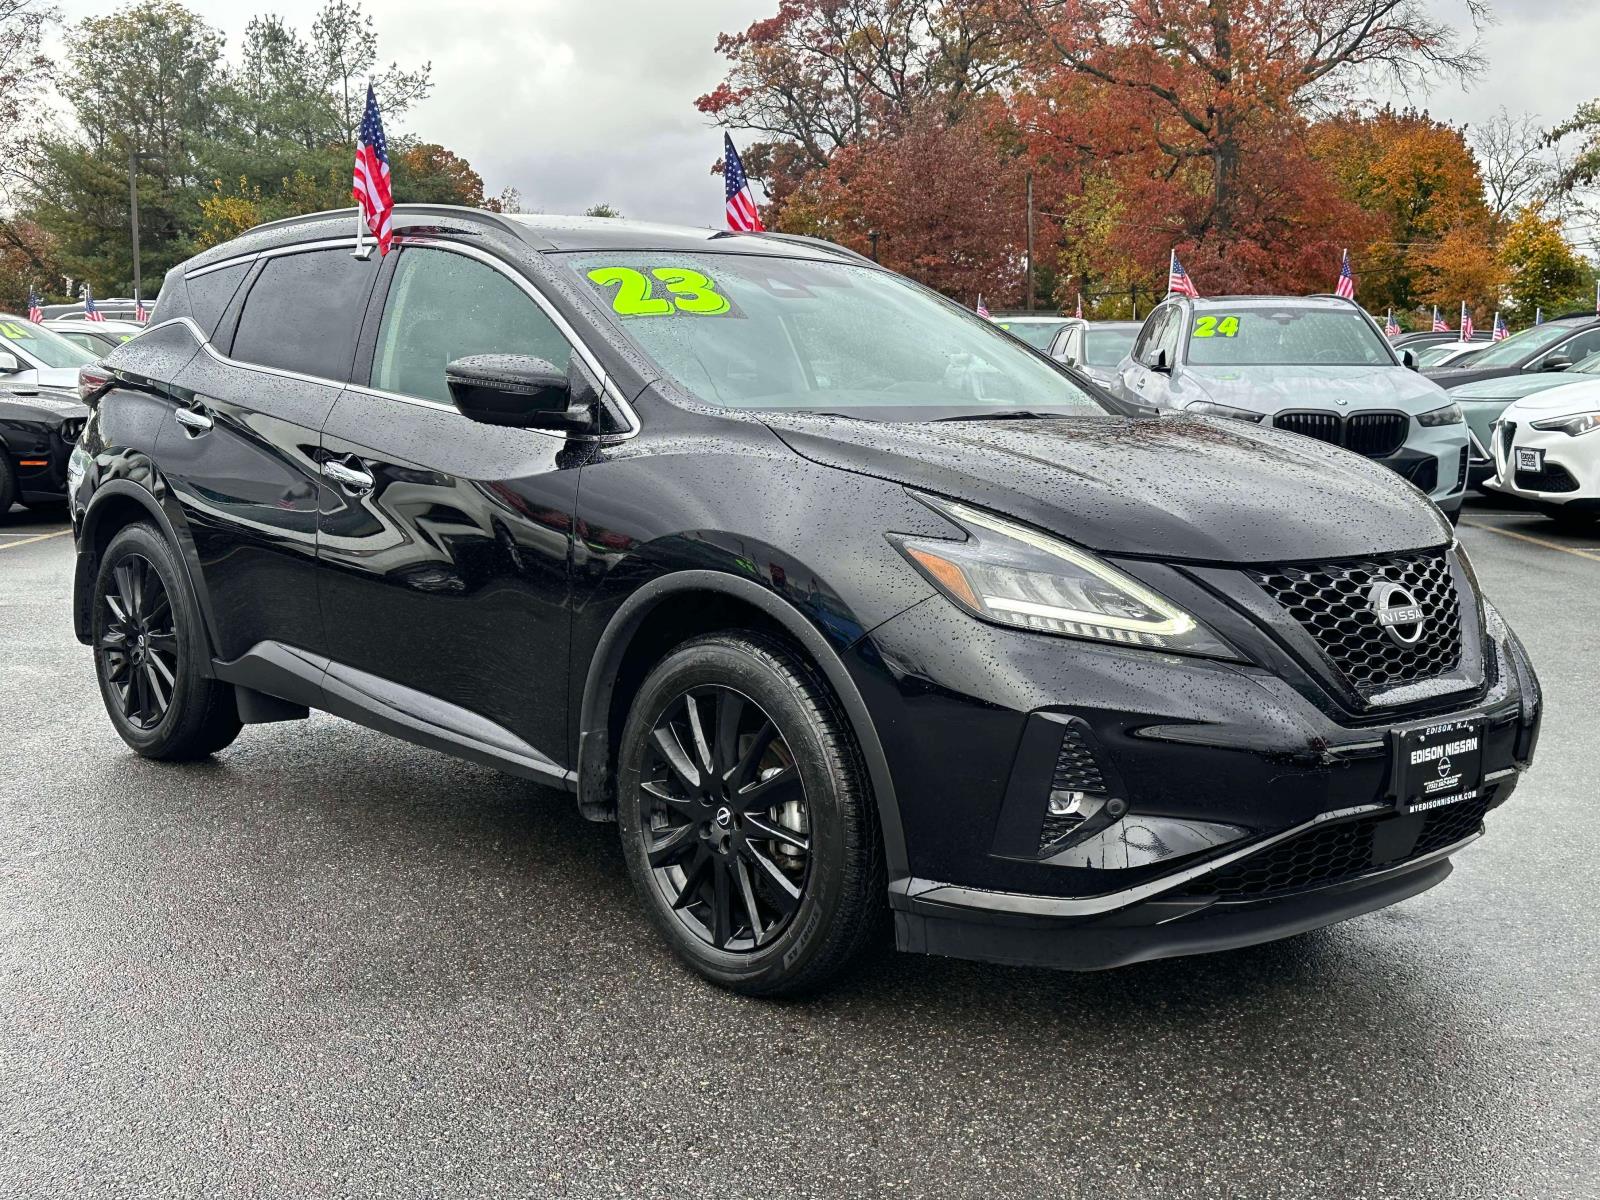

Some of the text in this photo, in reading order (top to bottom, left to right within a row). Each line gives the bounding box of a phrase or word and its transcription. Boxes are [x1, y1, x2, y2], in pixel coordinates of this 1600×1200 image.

[587, 267, 731, 316] 23
[0, 321, 35, 339] 24
[1193, 315, 1239, 337] 24
[1380, 609, 1424, 623] NISSA
[1426, 724, 1453, 735] EDISON,
[1411, 737, 1478, 764] EDISON NISSAN
[1410, 791, 1476, 812] MYEDISONNISSAN.COM
